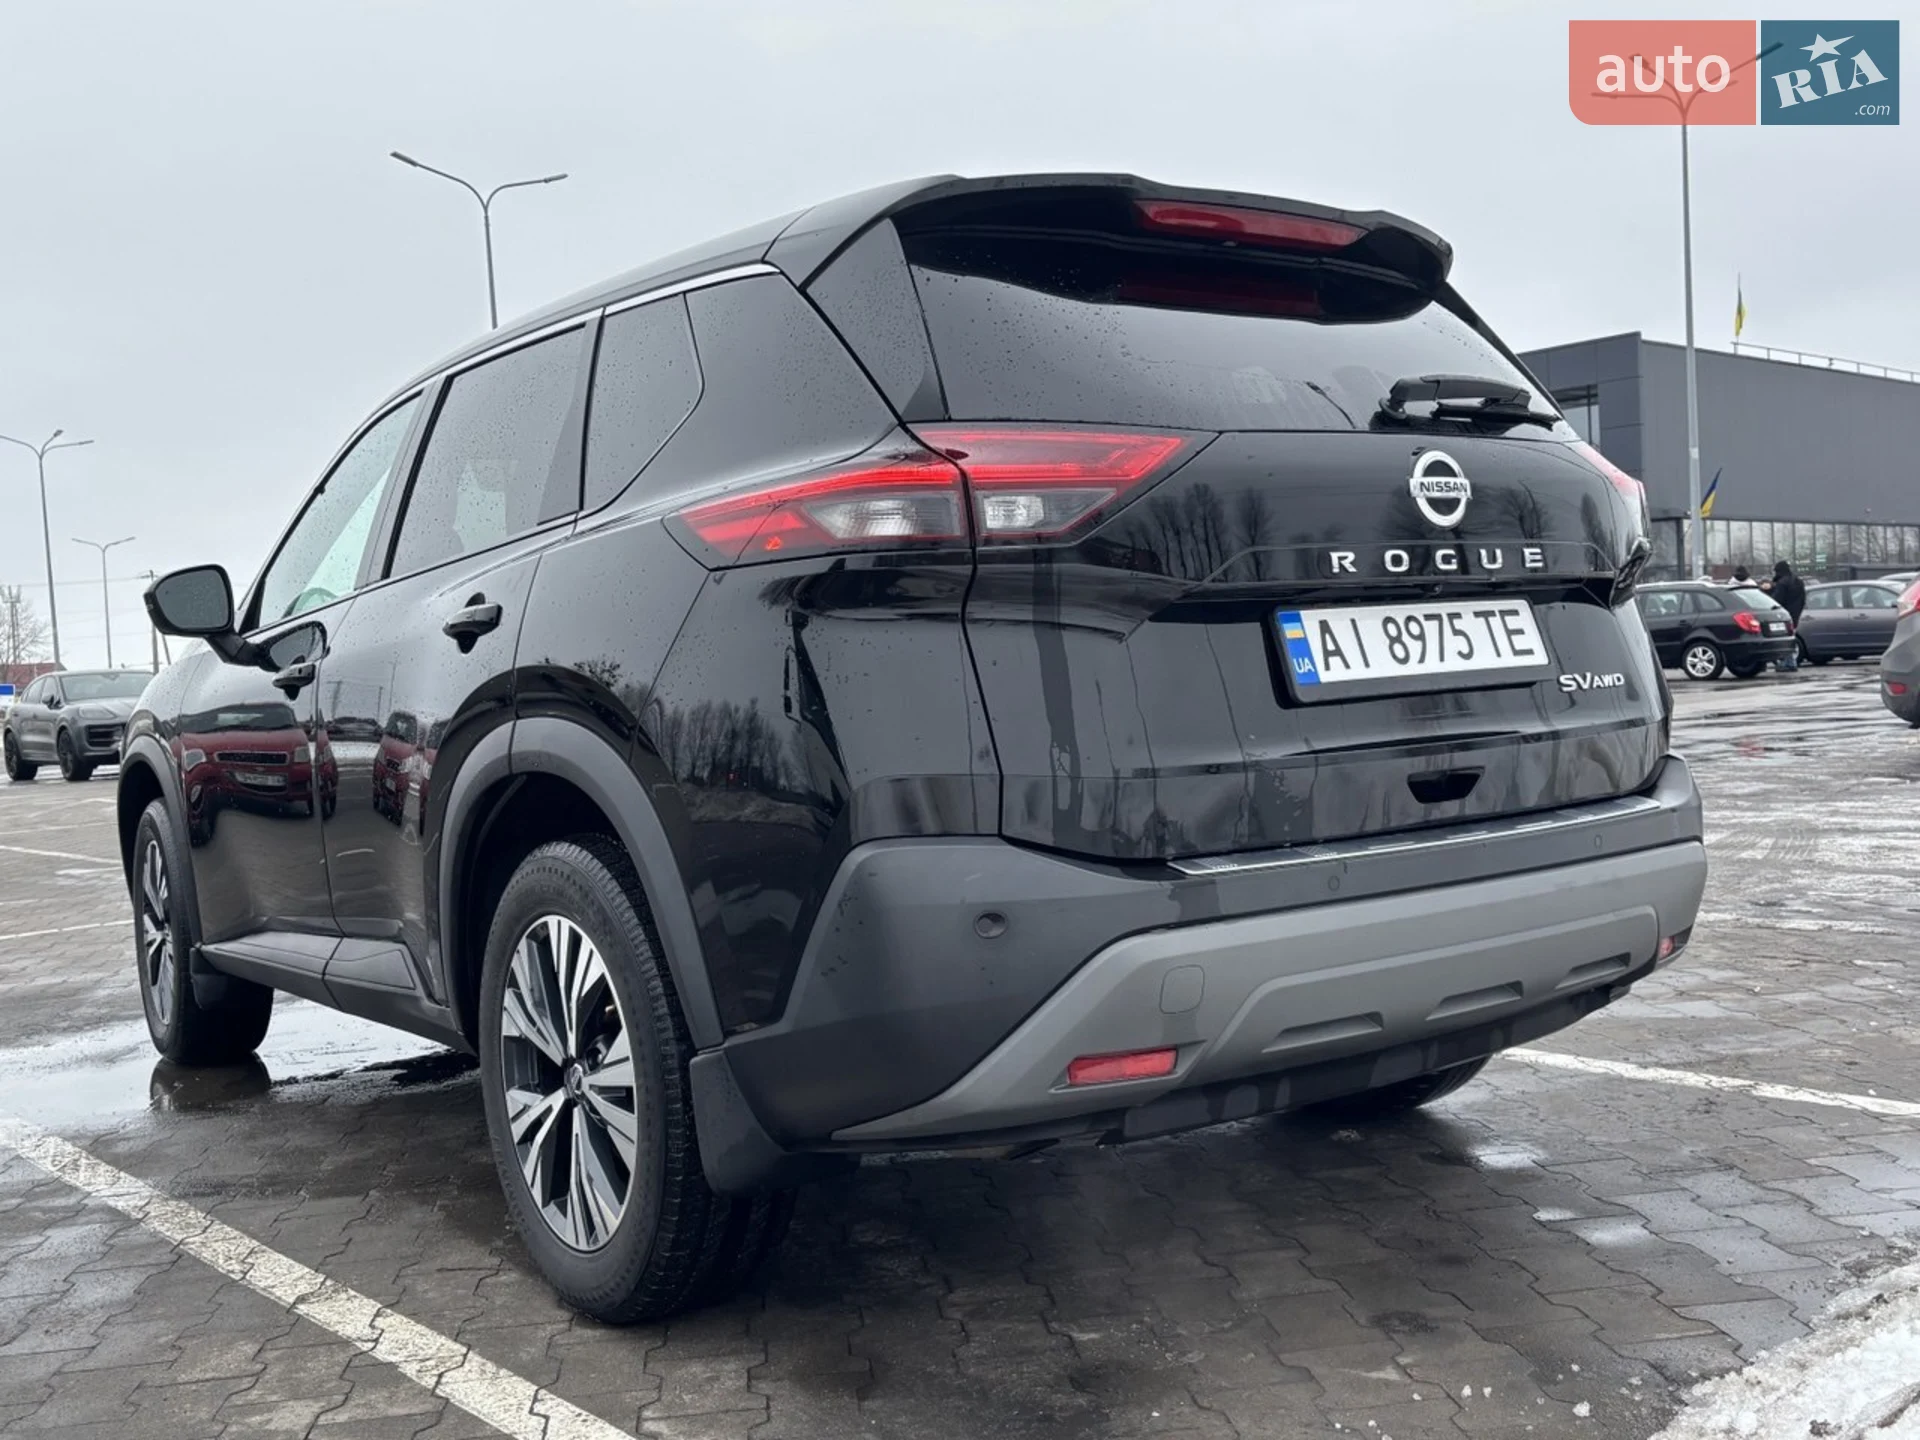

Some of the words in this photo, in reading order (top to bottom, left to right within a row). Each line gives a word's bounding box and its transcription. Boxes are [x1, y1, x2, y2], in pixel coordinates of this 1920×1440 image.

[1420, 481, 1468, 493] NISSAN
[1329, 548, 1544, 573] ROGUE
[1319, 618, 1371, 671] AI
[1382, 612, 1474, 665] 8975
[1473, 609, 1535, 658] TE
[1293, 657, 1315, 674] UA
